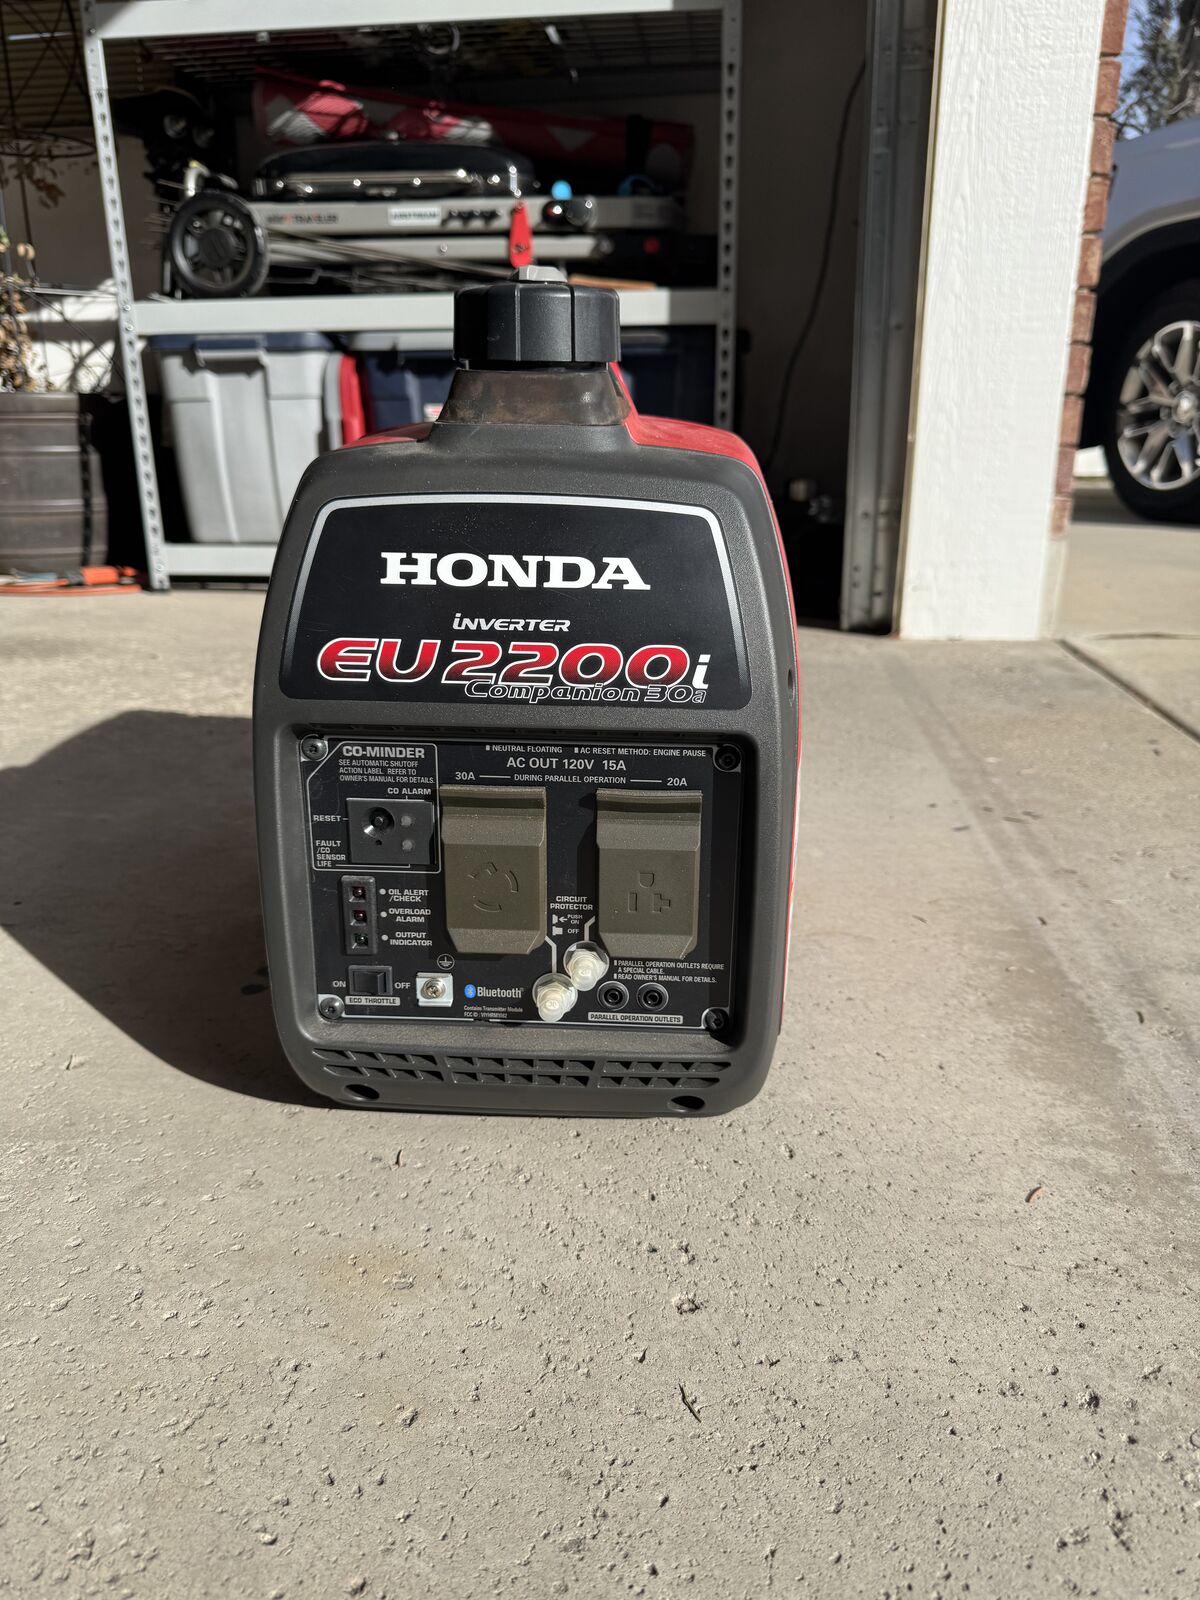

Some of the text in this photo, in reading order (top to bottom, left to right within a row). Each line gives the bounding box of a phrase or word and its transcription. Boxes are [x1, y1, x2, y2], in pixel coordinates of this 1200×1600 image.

[380, 551, 651, 591] HONDA
[464, 678, 641, 704] Companion
[342, 746, 425, 759] CO-MINDER
[506, 757, 626, 770] AC OUT 120V 15A
[455, 772, 476, 780] 30A
[544, 774, 582, 782] PARALLEL
[583, 776, 626, 784] OPERATION
[666, 777, 688, 786] 20A
[654, 1015, 681, 1023] OUTLETS
